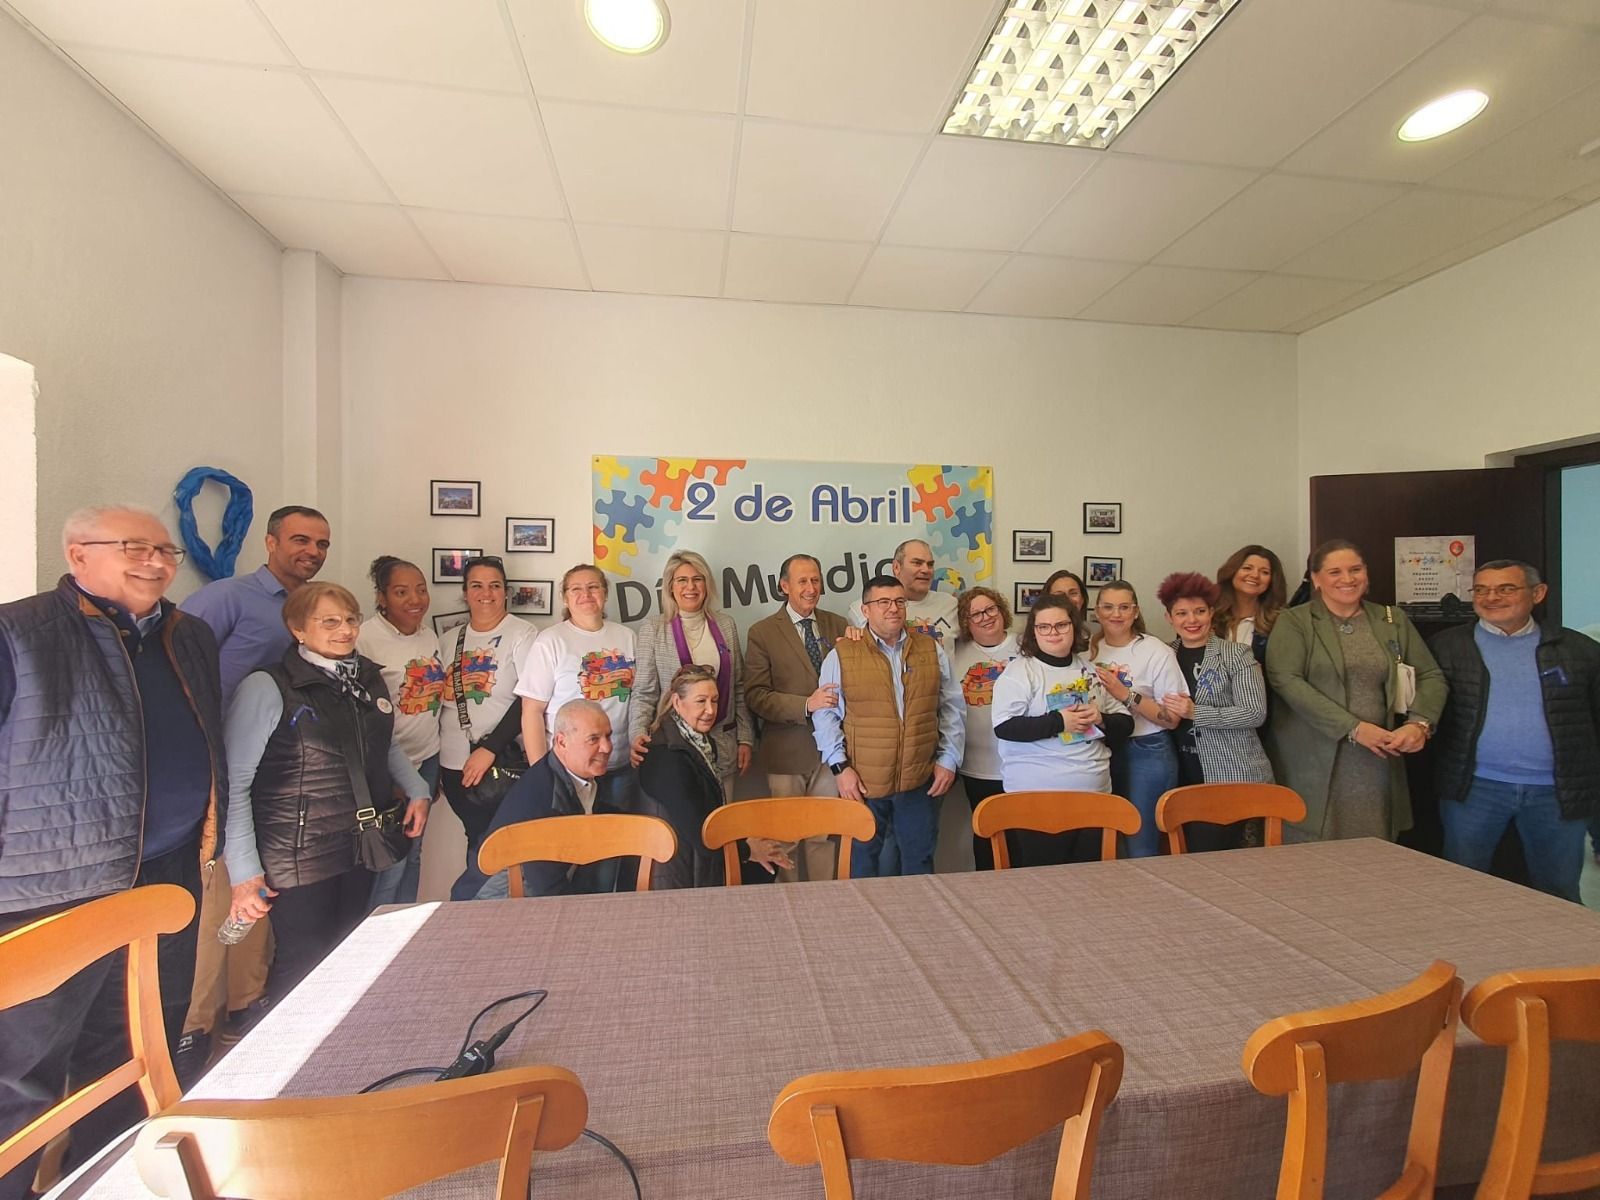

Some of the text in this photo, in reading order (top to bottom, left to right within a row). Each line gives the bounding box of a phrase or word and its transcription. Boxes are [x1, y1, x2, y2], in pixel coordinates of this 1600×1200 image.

[686, 482, 911, 523] 2 de Abril
[616, 578, 664, 623] Dí
[453, 671, 464, 698] BIMBA
